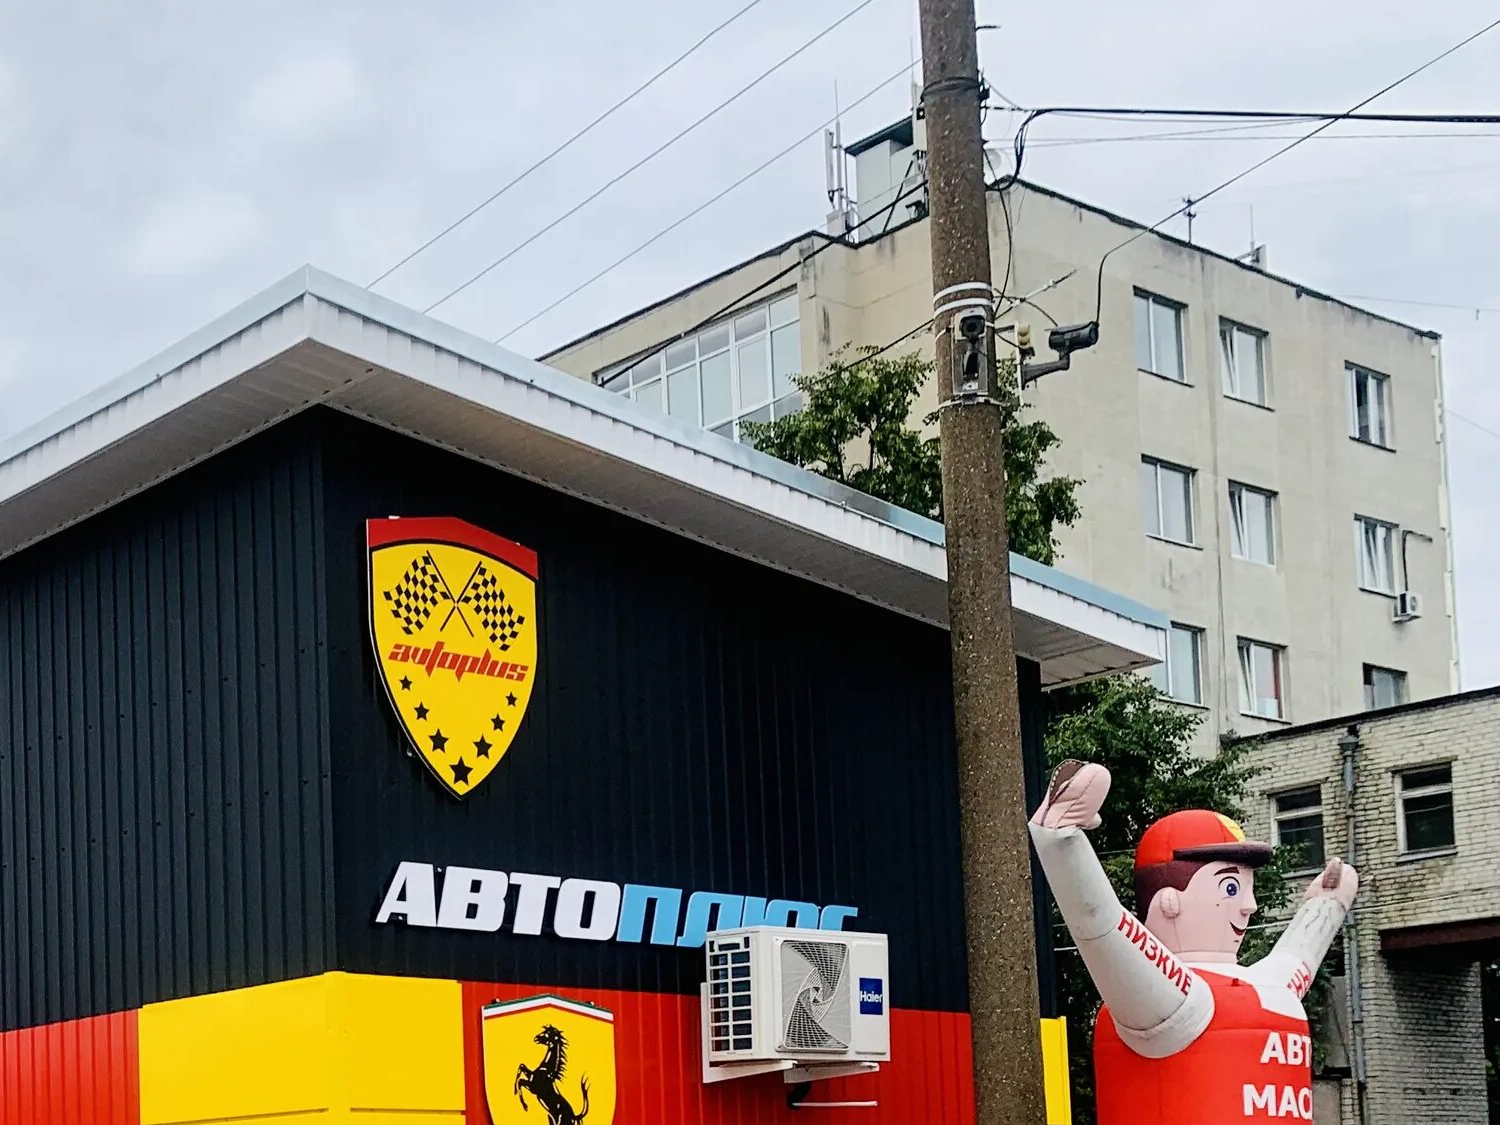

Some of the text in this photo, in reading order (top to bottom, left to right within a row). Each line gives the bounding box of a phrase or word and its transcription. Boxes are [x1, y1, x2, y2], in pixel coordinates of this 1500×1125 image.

[1118, 911, 1192, 996] НИЗКИЕ
[860, 990, 884, 1004] Haier
[1260, 1031, 1313, 1068] АВТ
[1243, 1084, 1313, 1120] МАС
